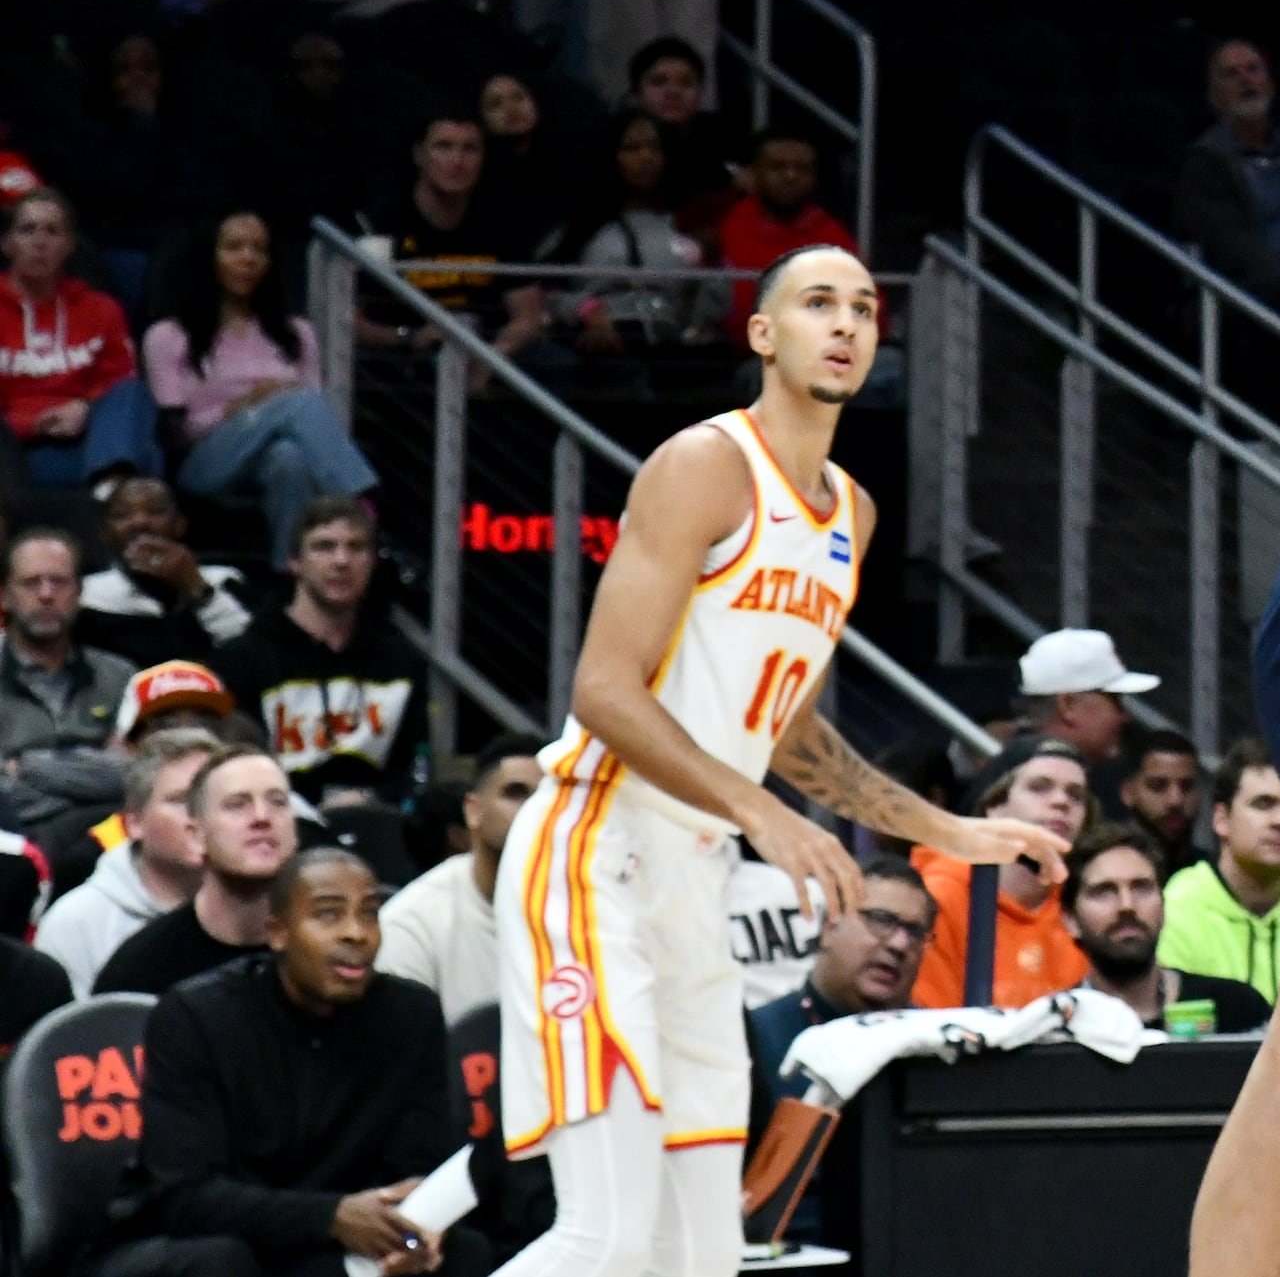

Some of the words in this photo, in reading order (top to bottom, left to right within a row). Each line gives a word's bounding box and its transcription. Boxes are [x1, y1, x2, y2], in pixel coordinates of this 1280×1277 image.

[727, 565, 850, 647] ATLANT
[743, 644, 811, 742] 10
[54, 1044, 146, 1100] PA
